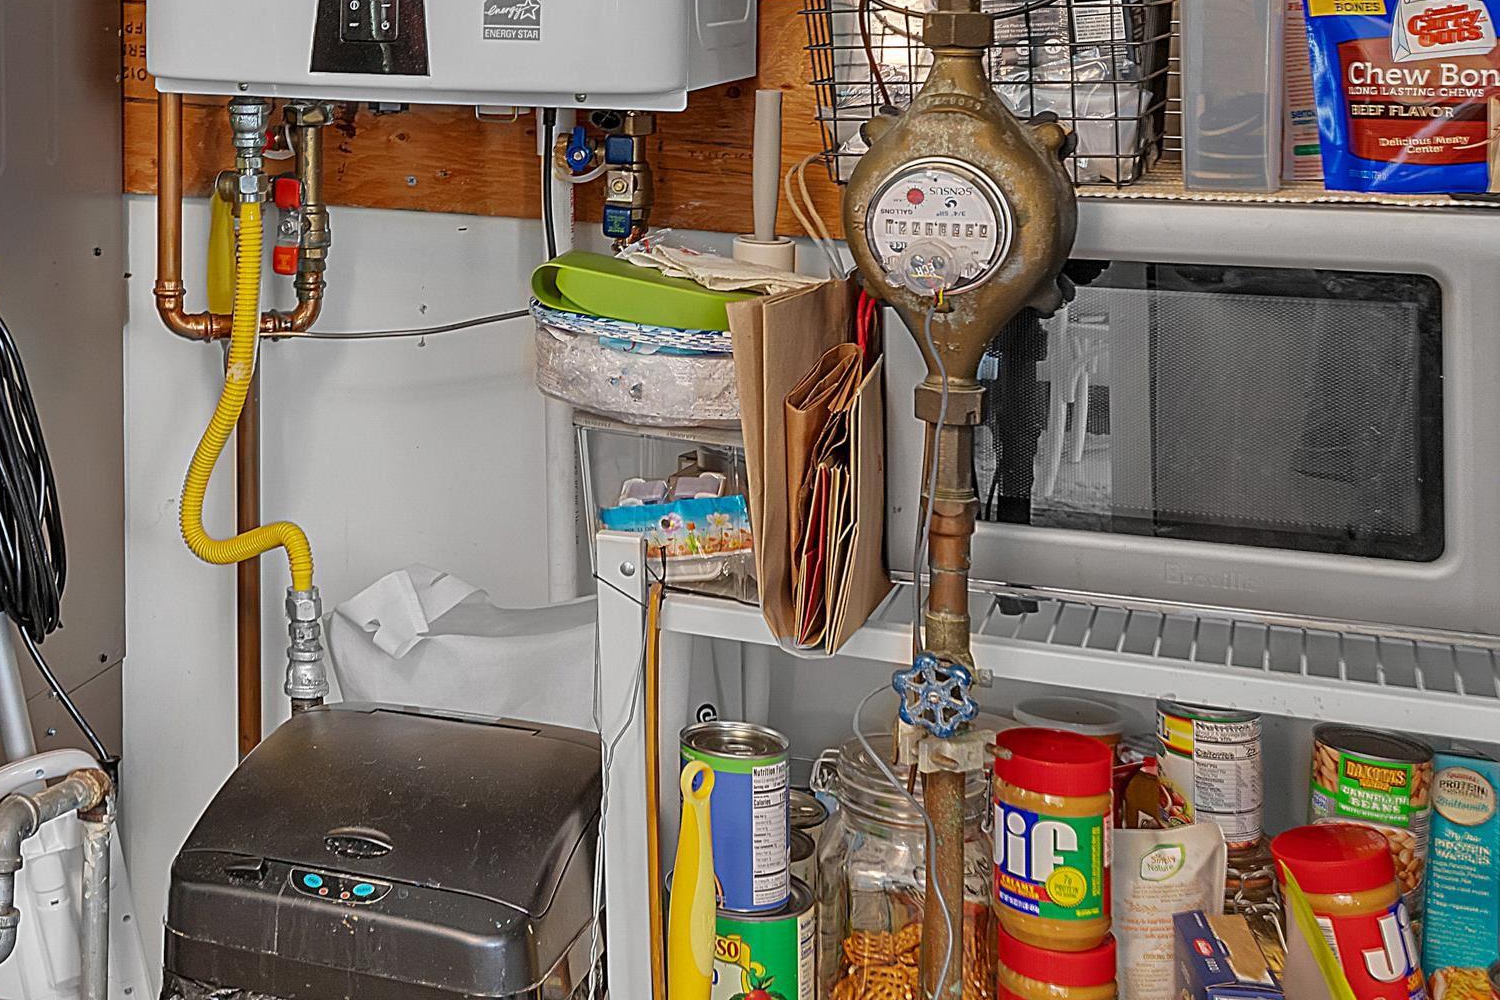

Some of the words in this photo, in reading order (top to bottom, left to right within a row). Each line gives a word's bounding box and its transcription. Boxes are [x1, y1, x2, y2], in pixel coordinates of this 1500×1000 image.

[484, 3, 525, 20] energy
[1336, 2, 1380, 13] BONES
[484, 28, 516, 39] ENERGY
[518, 28, 539, 39] STAR
[1349, 61, 1431, 86] Chew
[1348, 86, 1378, 96] LONG
[1380, 86, 1436, 96] LASTING
[1439, 88, 1484, 98] CHEWS
[1352, 104, 1386, 116] BEEF
[1389, 105, 1454, 118] FLAVOR
[1378, 136, 1432, 147] Delicious
[1407, 145, 1444, 154] Center
[1196, 748, 1235, 760] Calories
[754, 766, 776, 777] Nutrition
[1350, 798, 1400, 814] BEANS
[1150, 854, 1176, 866] Simply
[1147, 864, 1174, 872] Nature
